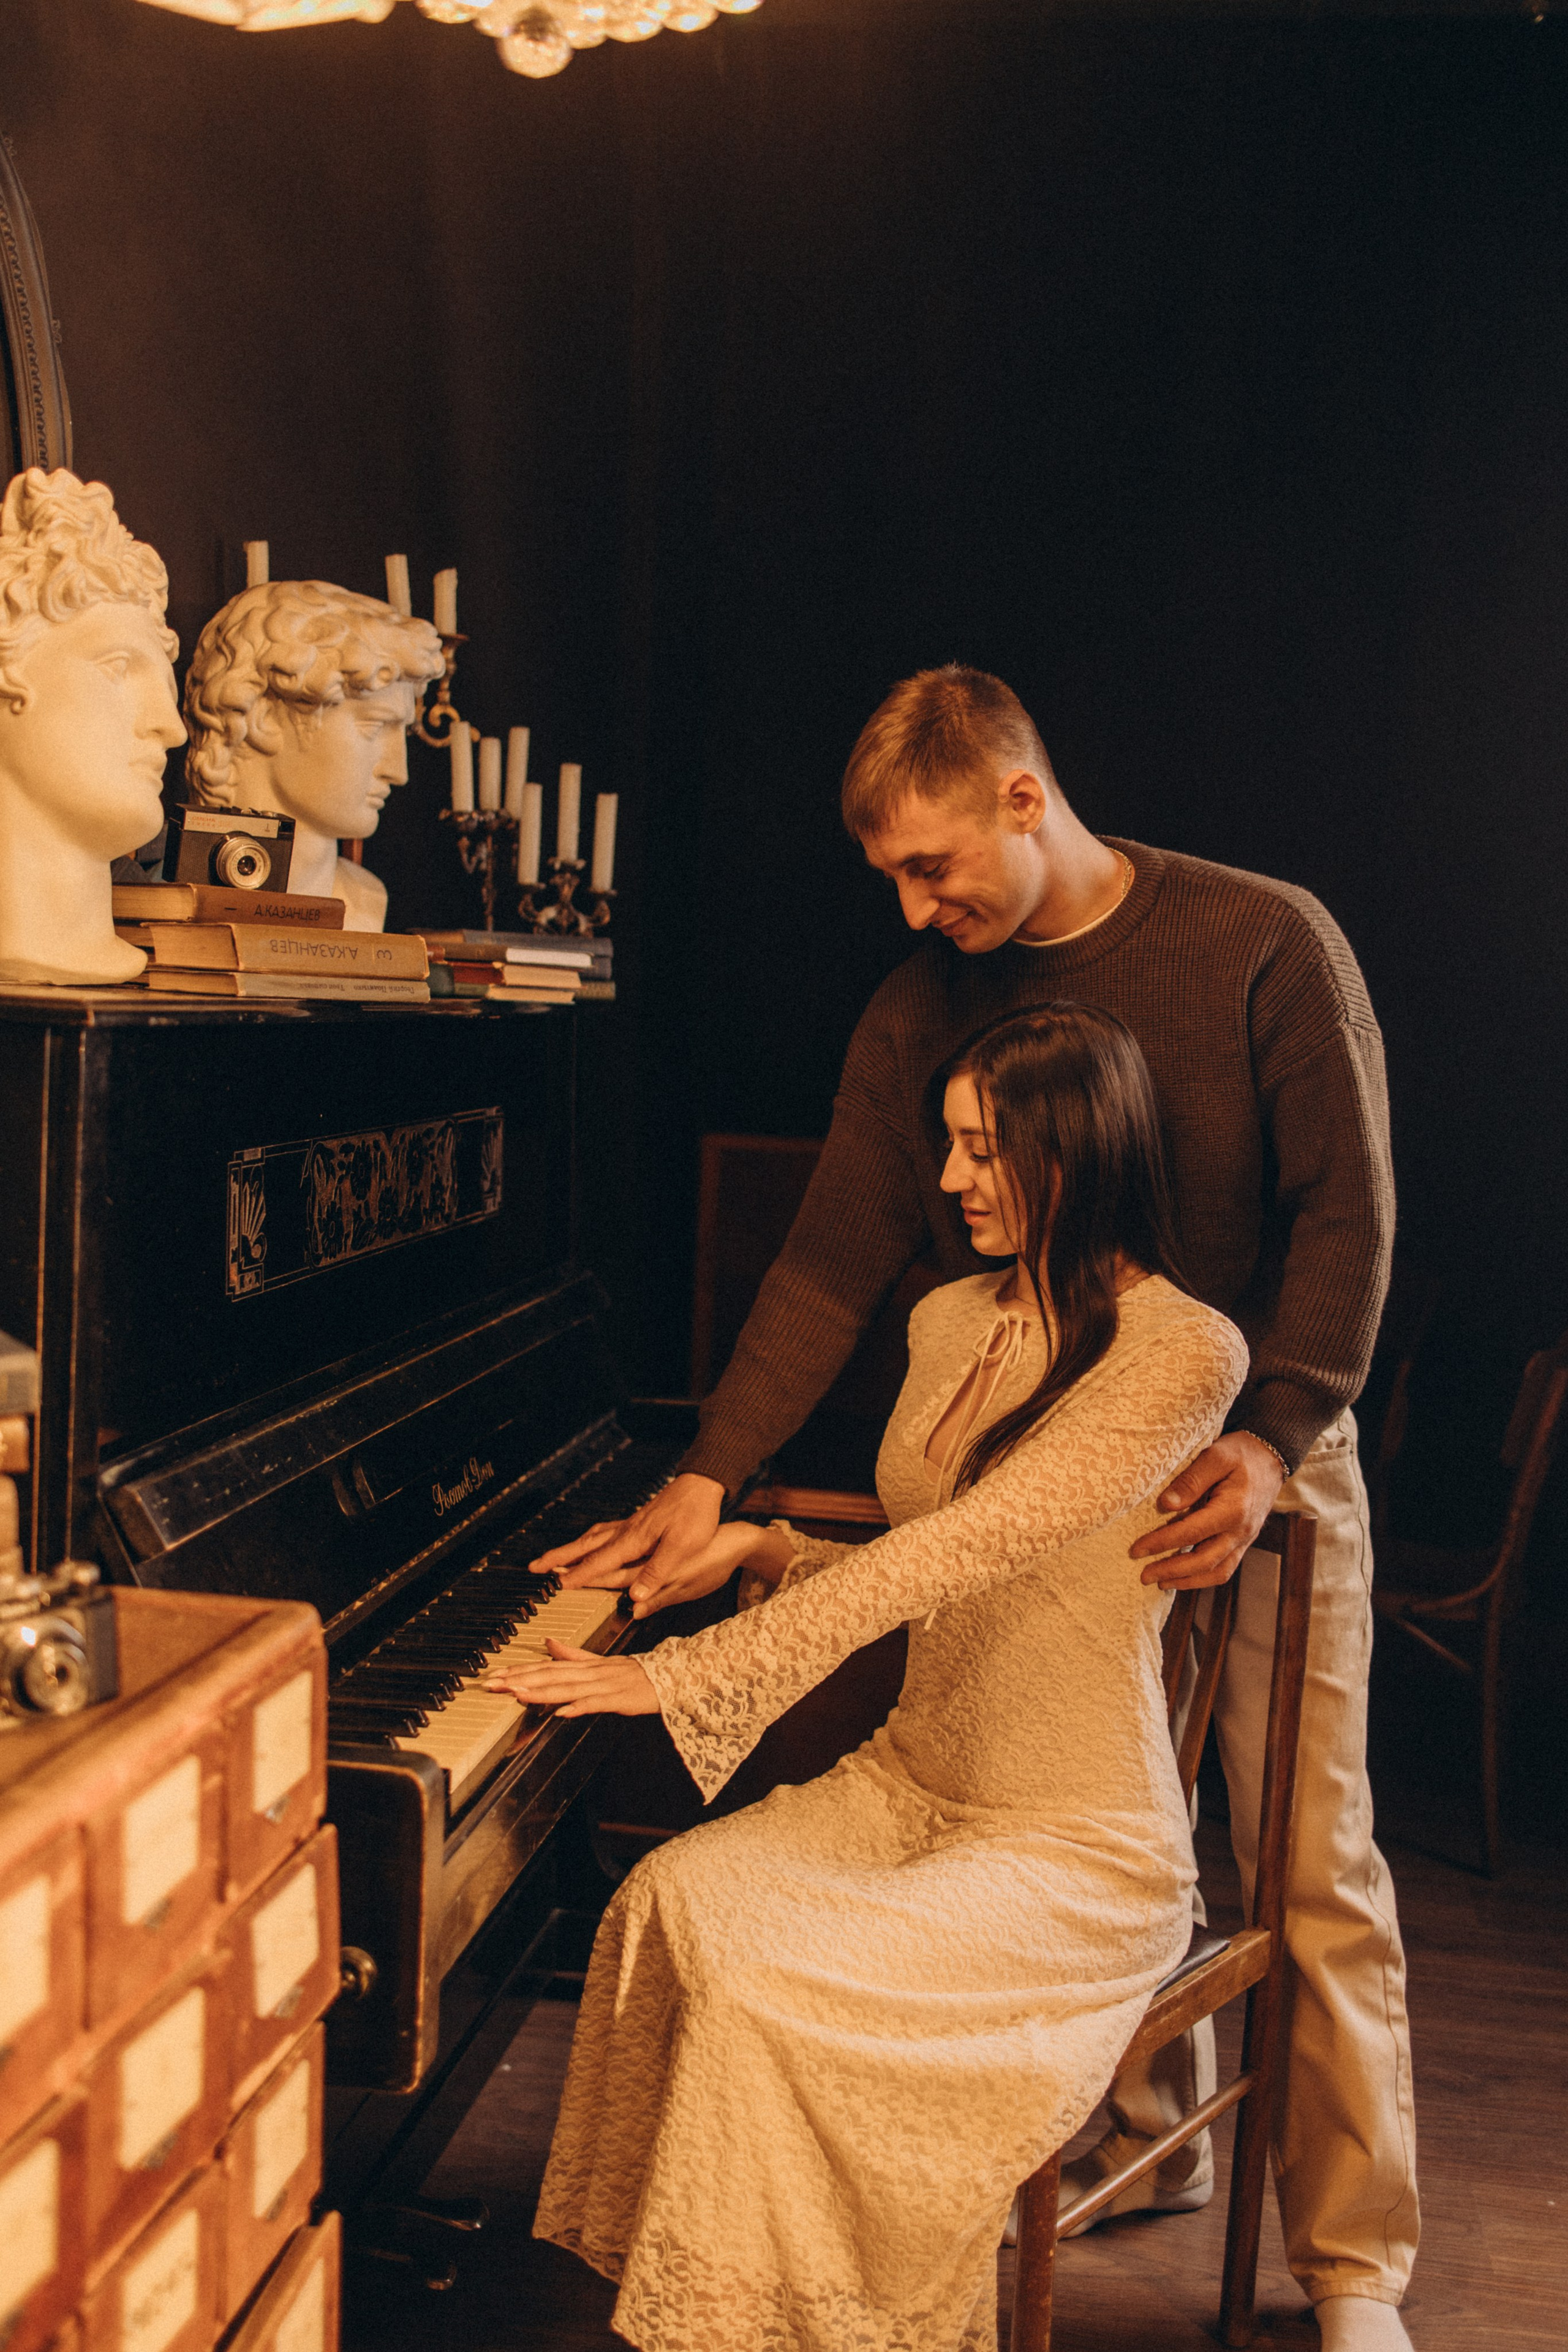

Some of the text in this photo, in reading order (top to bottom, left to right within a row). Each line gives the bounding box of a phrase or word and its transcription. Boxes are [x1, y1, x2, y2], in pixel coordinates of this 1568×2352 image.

[254, 904, 320, 921] А.КАЗАНЦЕВ
[270, 938, 358, 960] А.КАЗАНЦЕВ
[389, 986, 415, 994] Георгий
